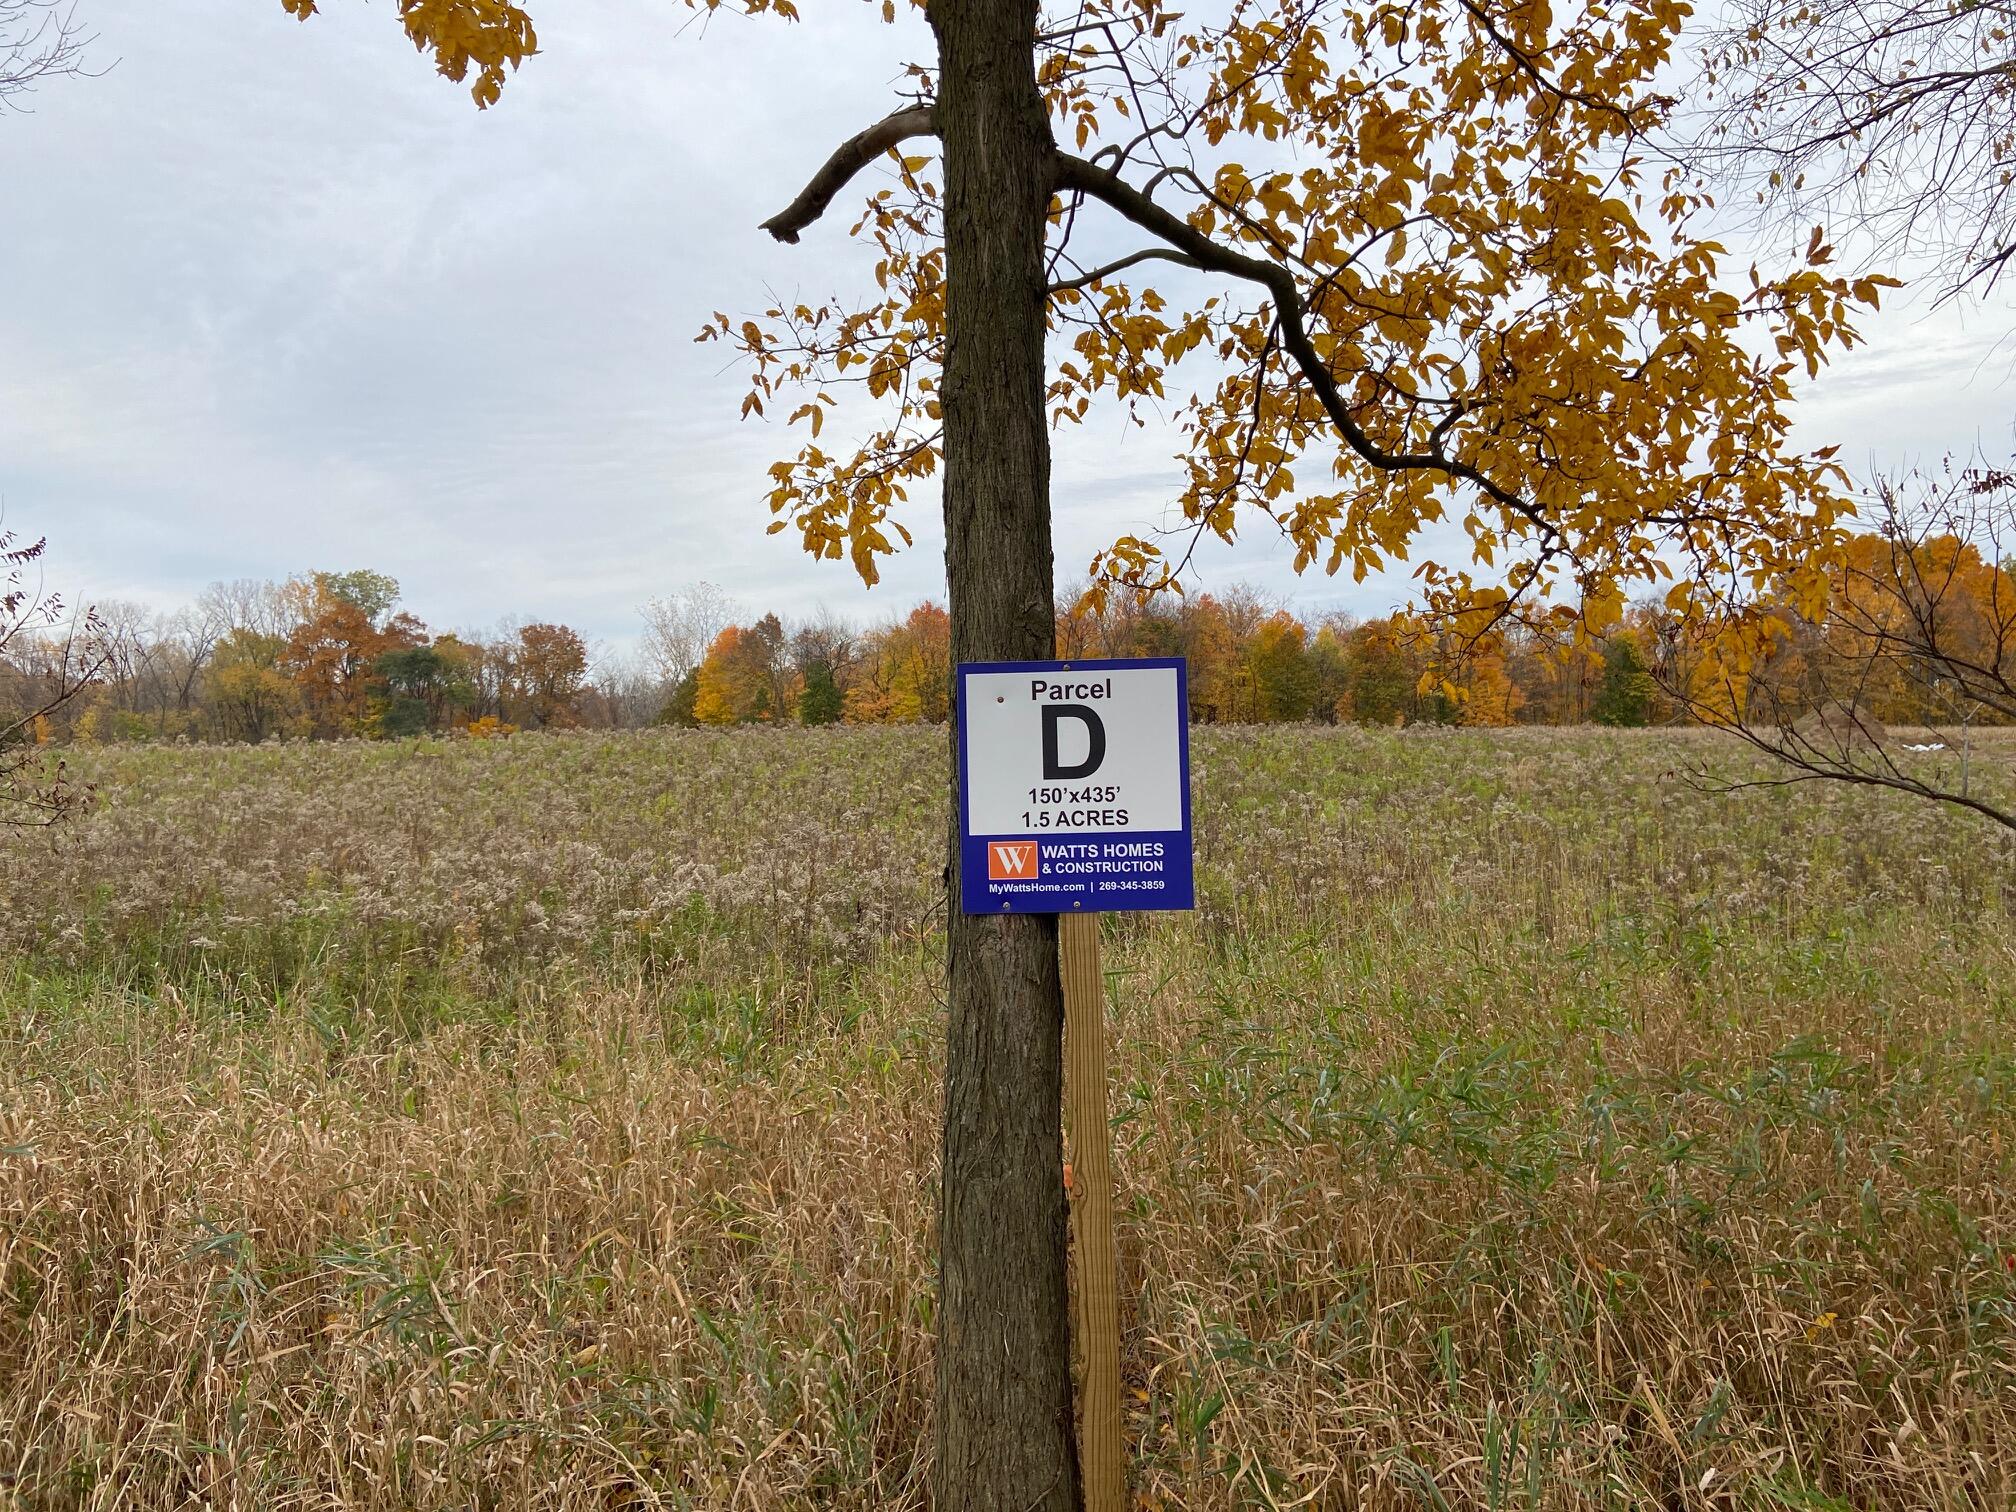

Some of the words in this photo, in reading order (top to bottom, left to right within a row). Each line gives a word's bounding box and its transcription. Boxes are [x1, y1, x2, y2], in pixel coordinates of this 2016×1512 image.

[1031, 678, 1112, 701] Parcel
[1041, 703, 1107, 781] D
[1021, 811, 1050, 828] 1.5
[1055, 809, 1129, 827] ACRES
[993, 845, 1033, 875] W
[1042, 844, 1098, 859] WATTS
[1103, 842, 1164, 857] HOMES
[1041, 862, 1052, 874] &
[1055, 860, 1163, 874] CONSTRUCTION
[989, 882, 1085, 895] MyWattsHome.com
[1098, 880, 1165, 891] 269-345-3859
